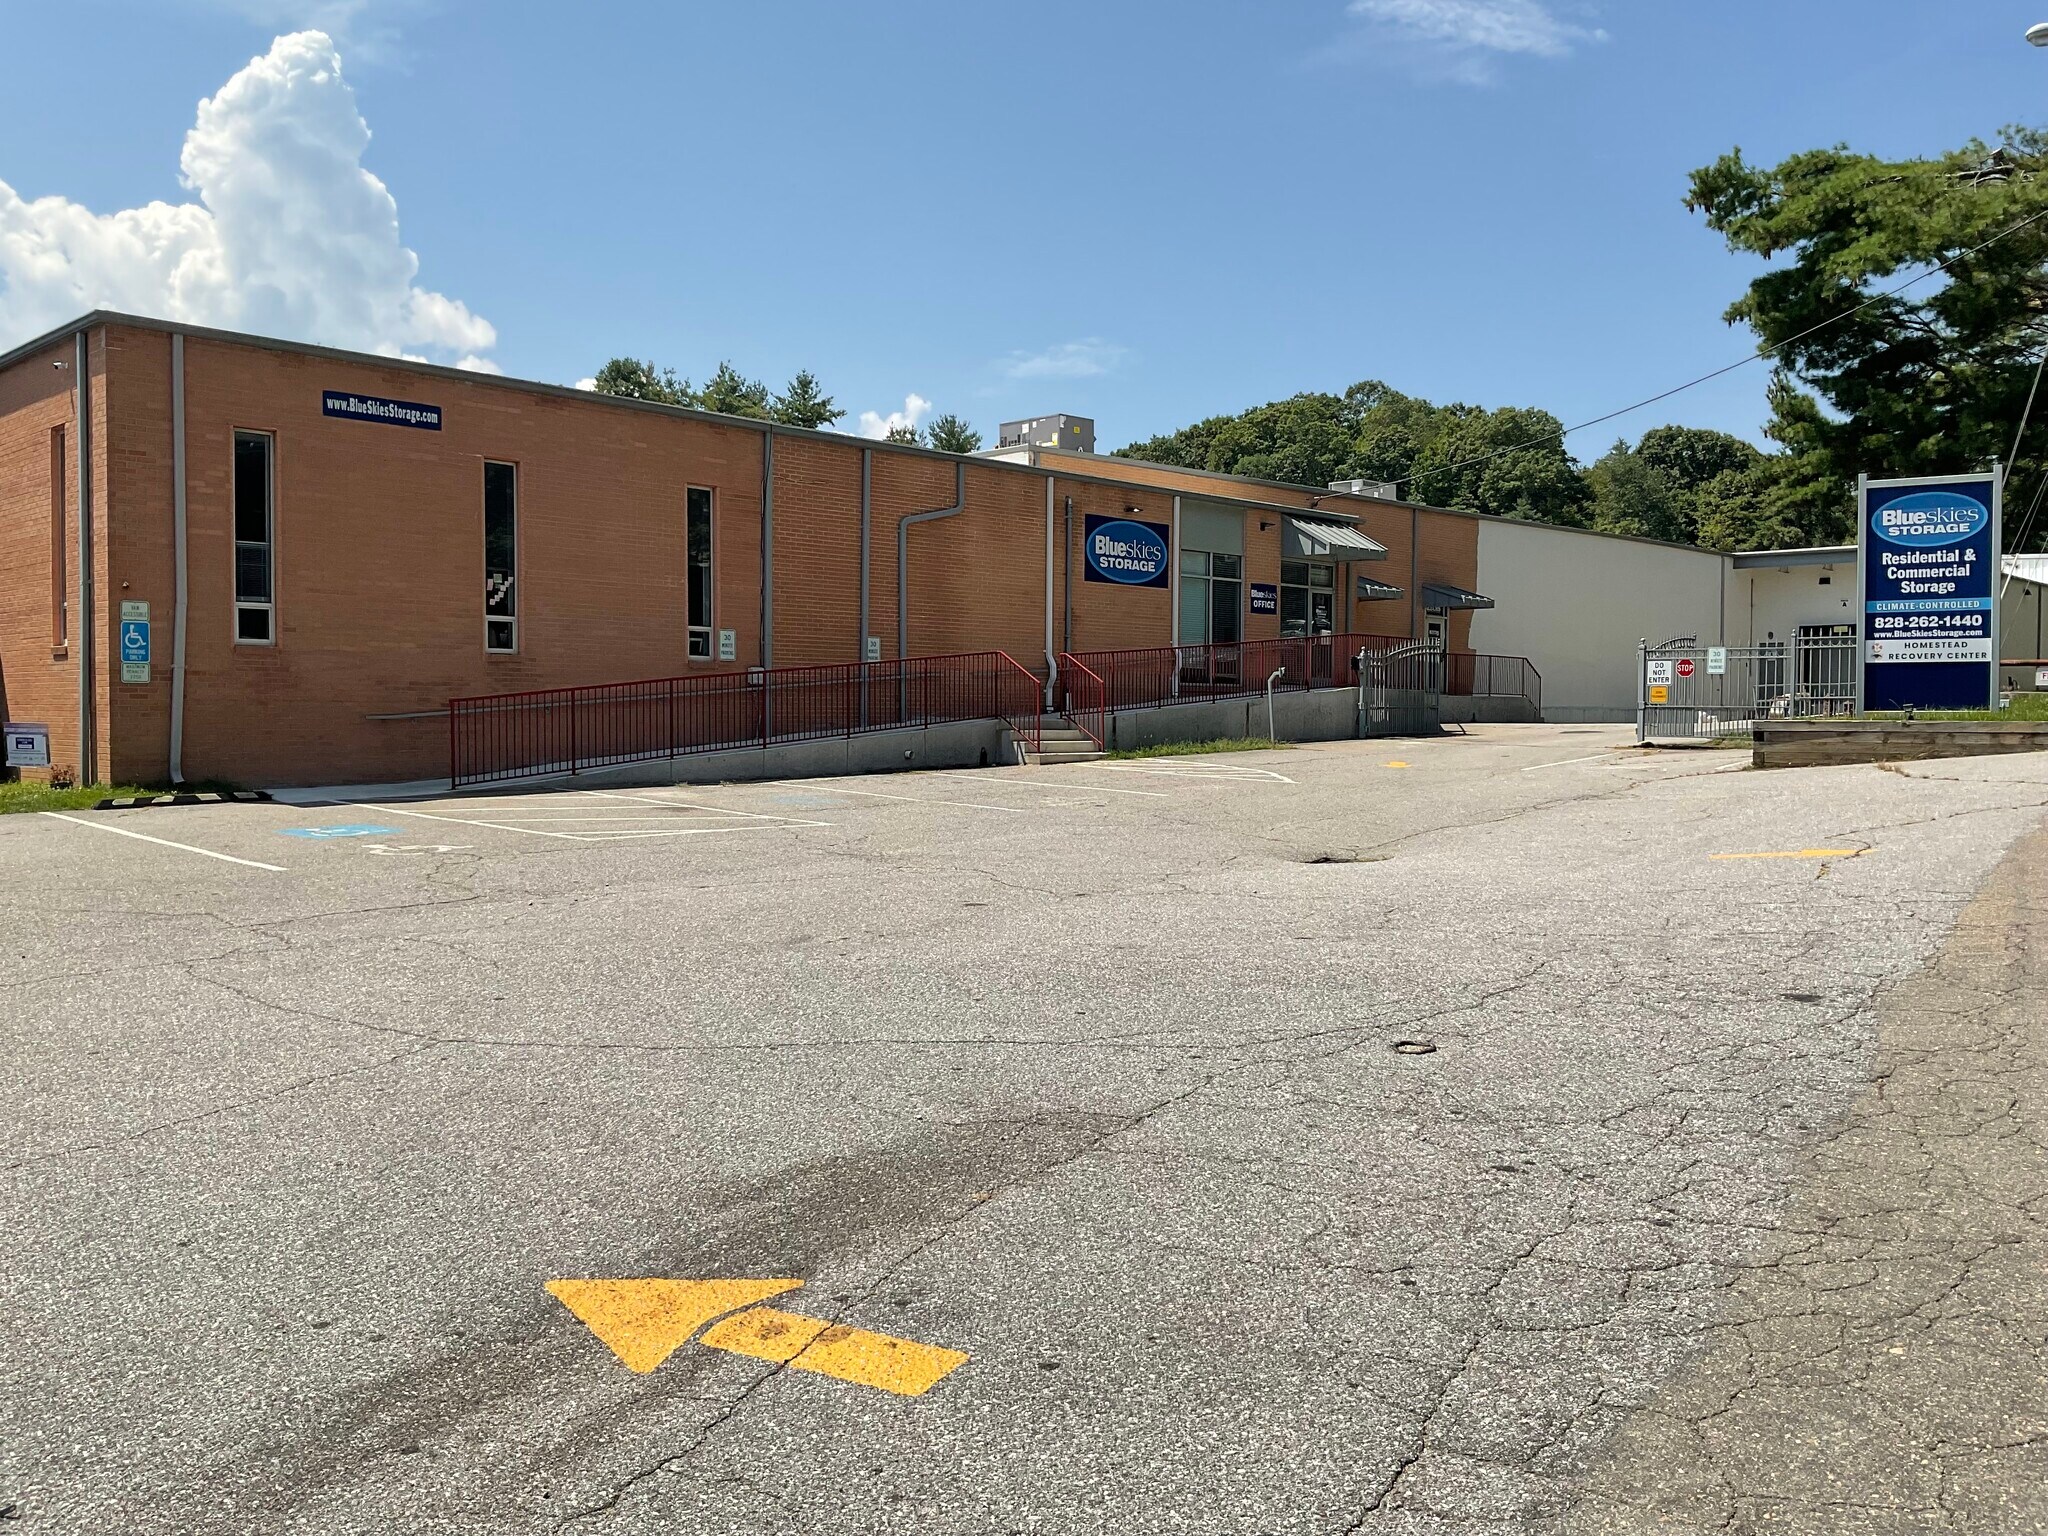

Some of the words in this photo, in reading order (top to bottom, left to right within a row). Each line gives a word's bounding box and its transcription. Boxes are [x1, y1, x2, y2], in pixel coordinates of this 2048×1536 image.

[326, 397, 438, 424] www.BlueSkiesStorage.com
[1882, 507, 1979, 526] Blueskies
[1888, 523, 1970, 536] STORAGE
[1095, 535, 1161, 560] Blueskies
[1882, 549, 1960, 565] Residential
[1964, 548, 1976, 561] &
[1100, 557, 1156, 572] STORAGE
[1887, 564, 1970, 579] Commercial
[1901, 581, 1956, 594] Storage
[1253, 600, 1275, 609] OFFICE
[1876, 601, 1980, 611] CLIMATE-CONTROLLED
[1874, 615, 1982, 628] 828-262-1440
[1874, 629, 1982, 638] www.BlueSkiesStorage.com
[1904, 641, 1968, 649] HOMESTEAD
[1888, 652, 1943, 660] RECOVERY
[1677, 664, 1694, 672] STOP
